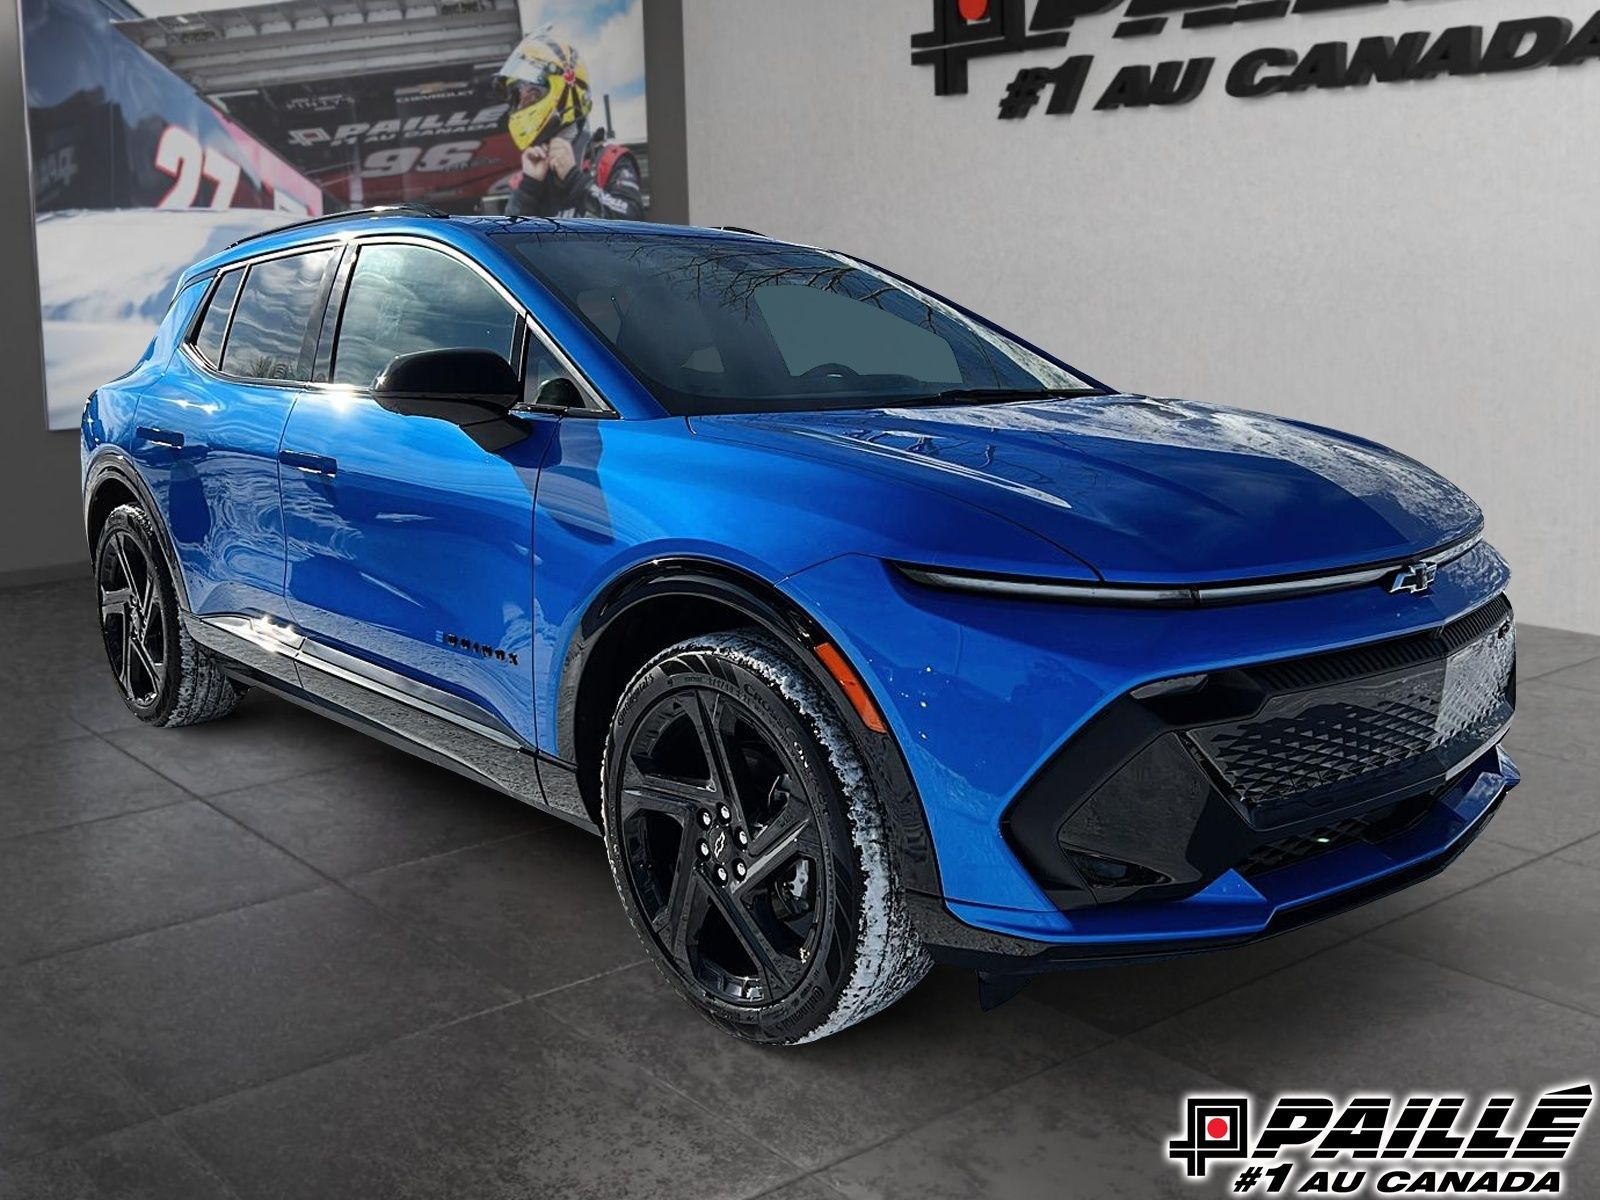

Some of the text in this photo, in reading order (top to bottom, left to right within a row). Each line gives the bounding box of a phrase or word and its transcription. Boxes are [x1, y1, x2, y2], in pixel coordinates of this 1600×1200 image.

[997, 54, 1094, 119] #1
[1092, 56, 1216, 110] AU
[360, 140, 482, 178] 96
